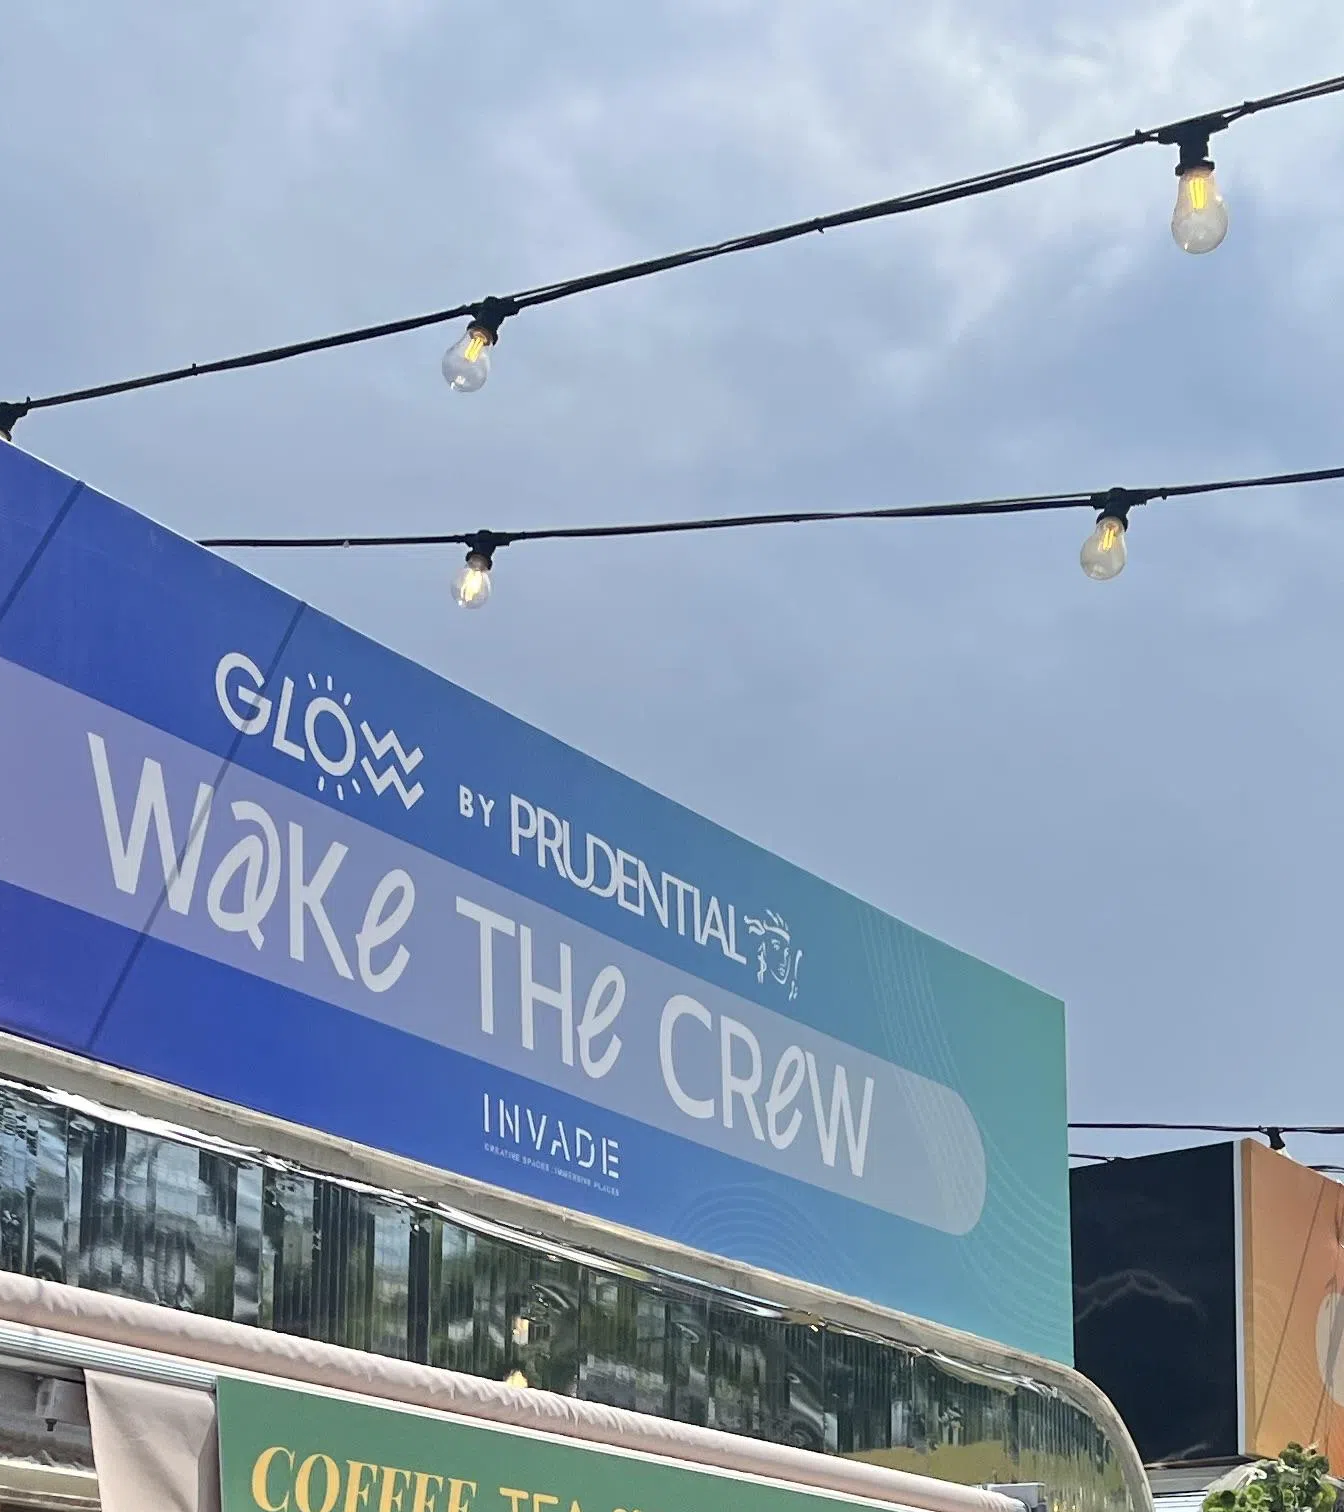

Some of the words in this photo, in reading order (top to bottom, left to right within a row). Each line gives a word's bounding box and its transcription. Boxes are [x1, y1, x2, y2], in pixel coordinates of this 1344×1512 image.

[214, 651, 424, 811] GLOW
[459, 785, 496, 827] BY
[509, 793, 748, 965] PRUDENTIAL
[483, 1092, 621, 1180] INVADE
